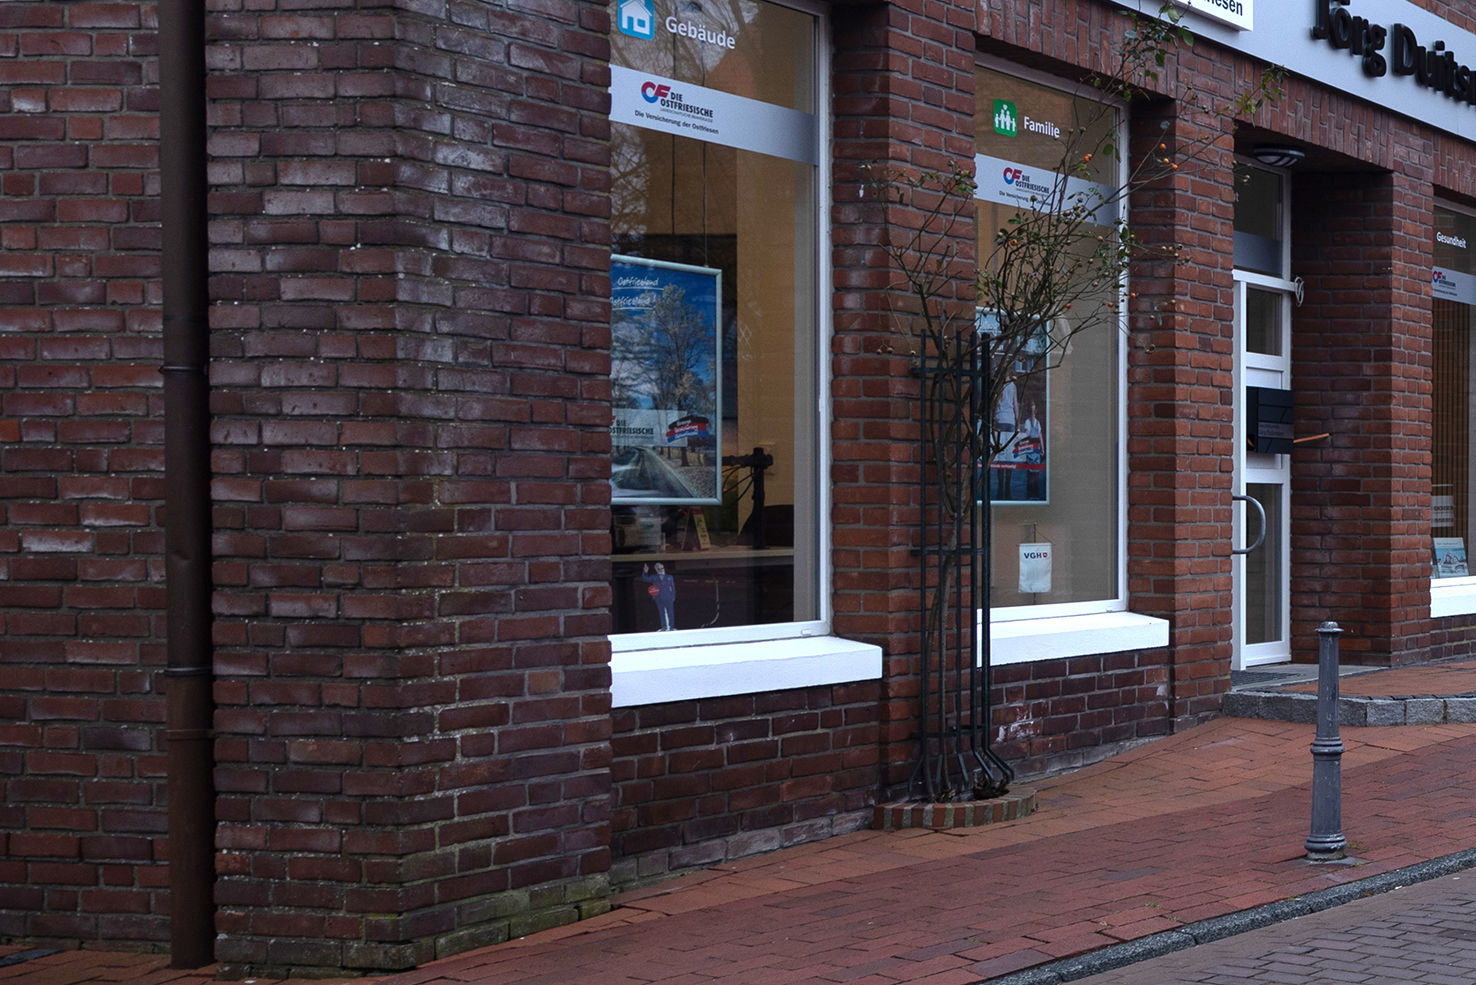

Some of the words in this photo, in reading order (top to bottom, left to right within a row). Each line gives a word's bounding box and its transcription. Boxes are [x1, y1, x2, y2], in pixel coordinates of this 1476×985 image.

[665, 16, 735, 49] Gebäude
[671, 91, 683, 102] DIE
[660, 98, 713, 118] OSTFRIESISCHE
[634, 109, 644, 118] Die
[645, 112, 681, 127] Versicherung
[692, 123, 719, 134] Ostfriesen
[1023, 116, 1060, 138] Familie
[1015, 180, 1049, 194] OSTFRIESISCHE
[1022, 174, 1030, 182] DIE
[1436, 231, 1466, 249] Gesundheit
[616, 419, 626, 427] DIE
